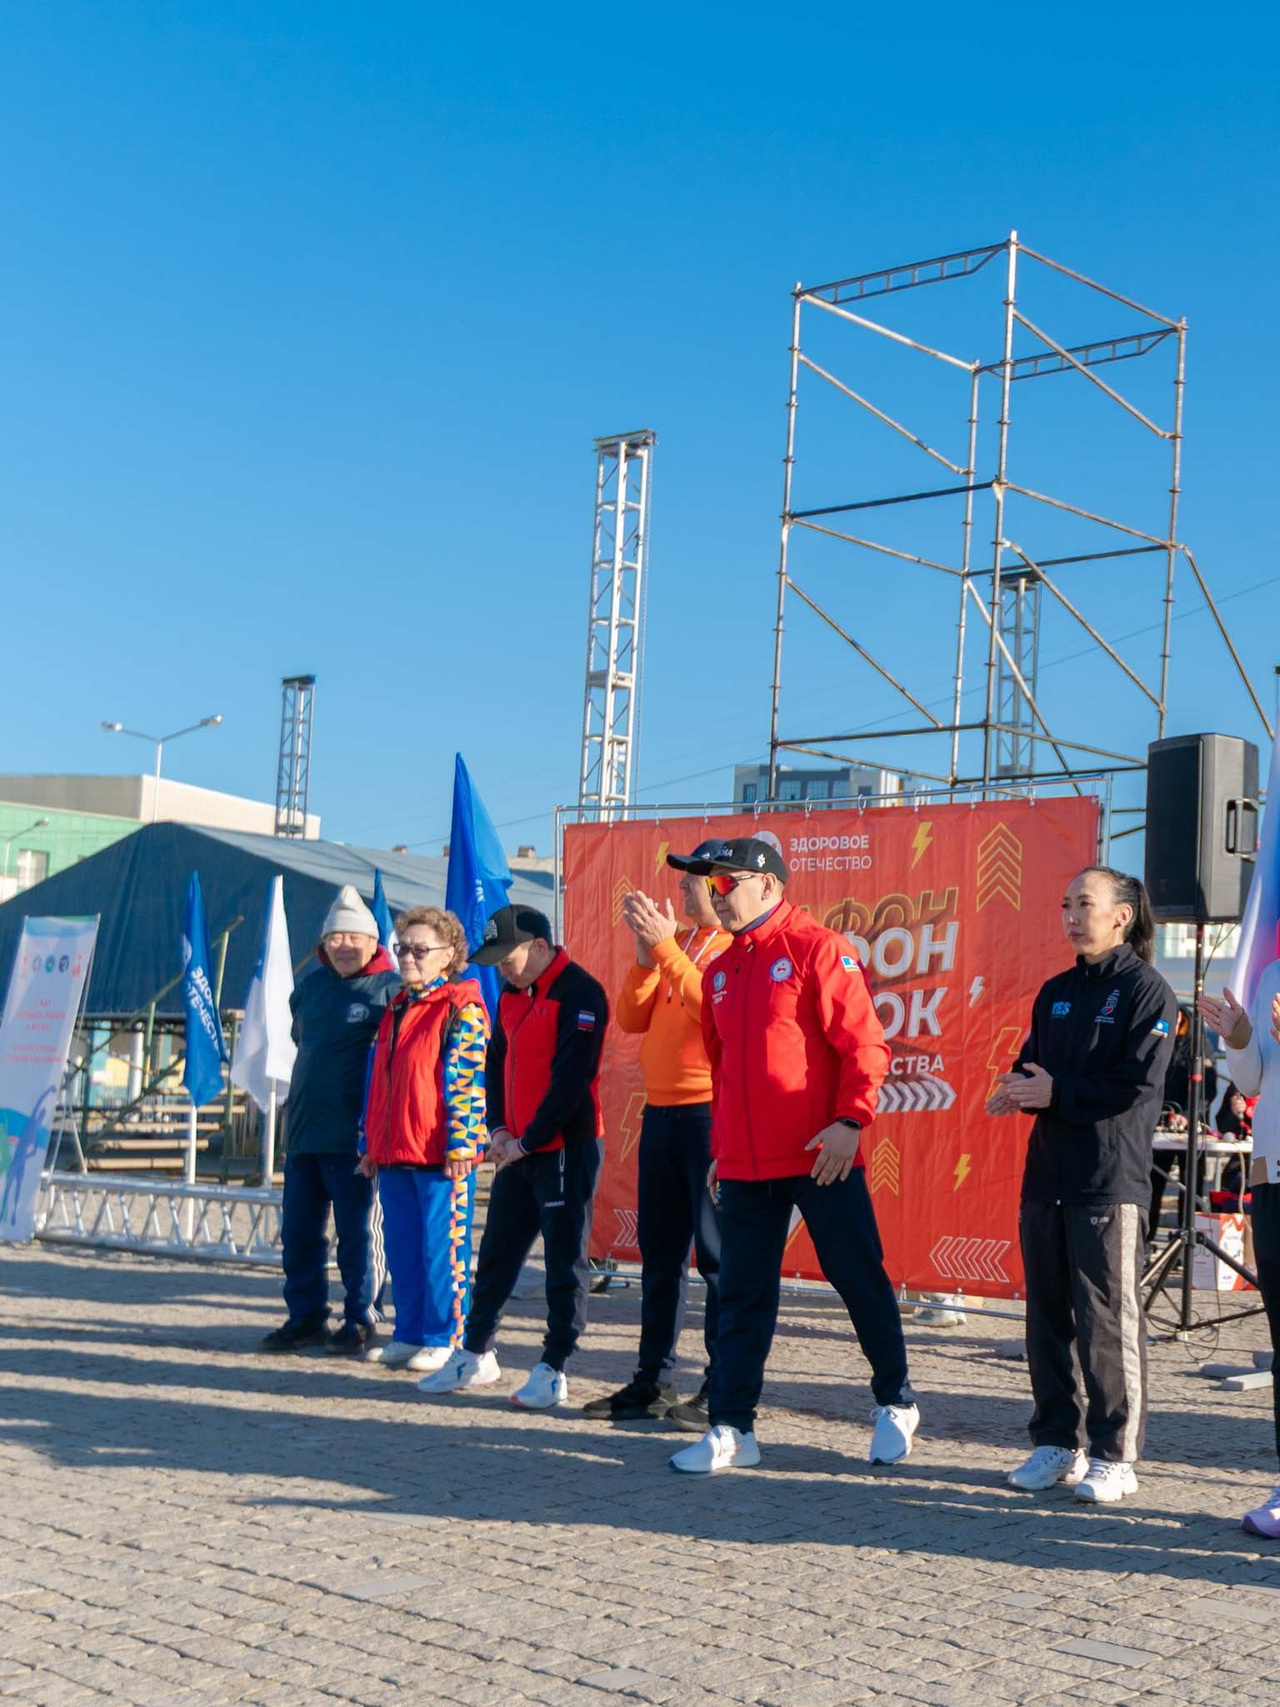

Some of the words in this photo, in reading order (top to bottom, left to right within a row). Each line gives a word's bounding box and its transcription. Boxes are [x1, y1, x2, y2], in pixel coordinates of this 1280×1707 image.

[790, 835, 869, 852] ЗДОРОВОЕ
[790, 856, 872, 872] ОТЕЧЕСТВО
[885, 1054, 945, 1076] СТВА
